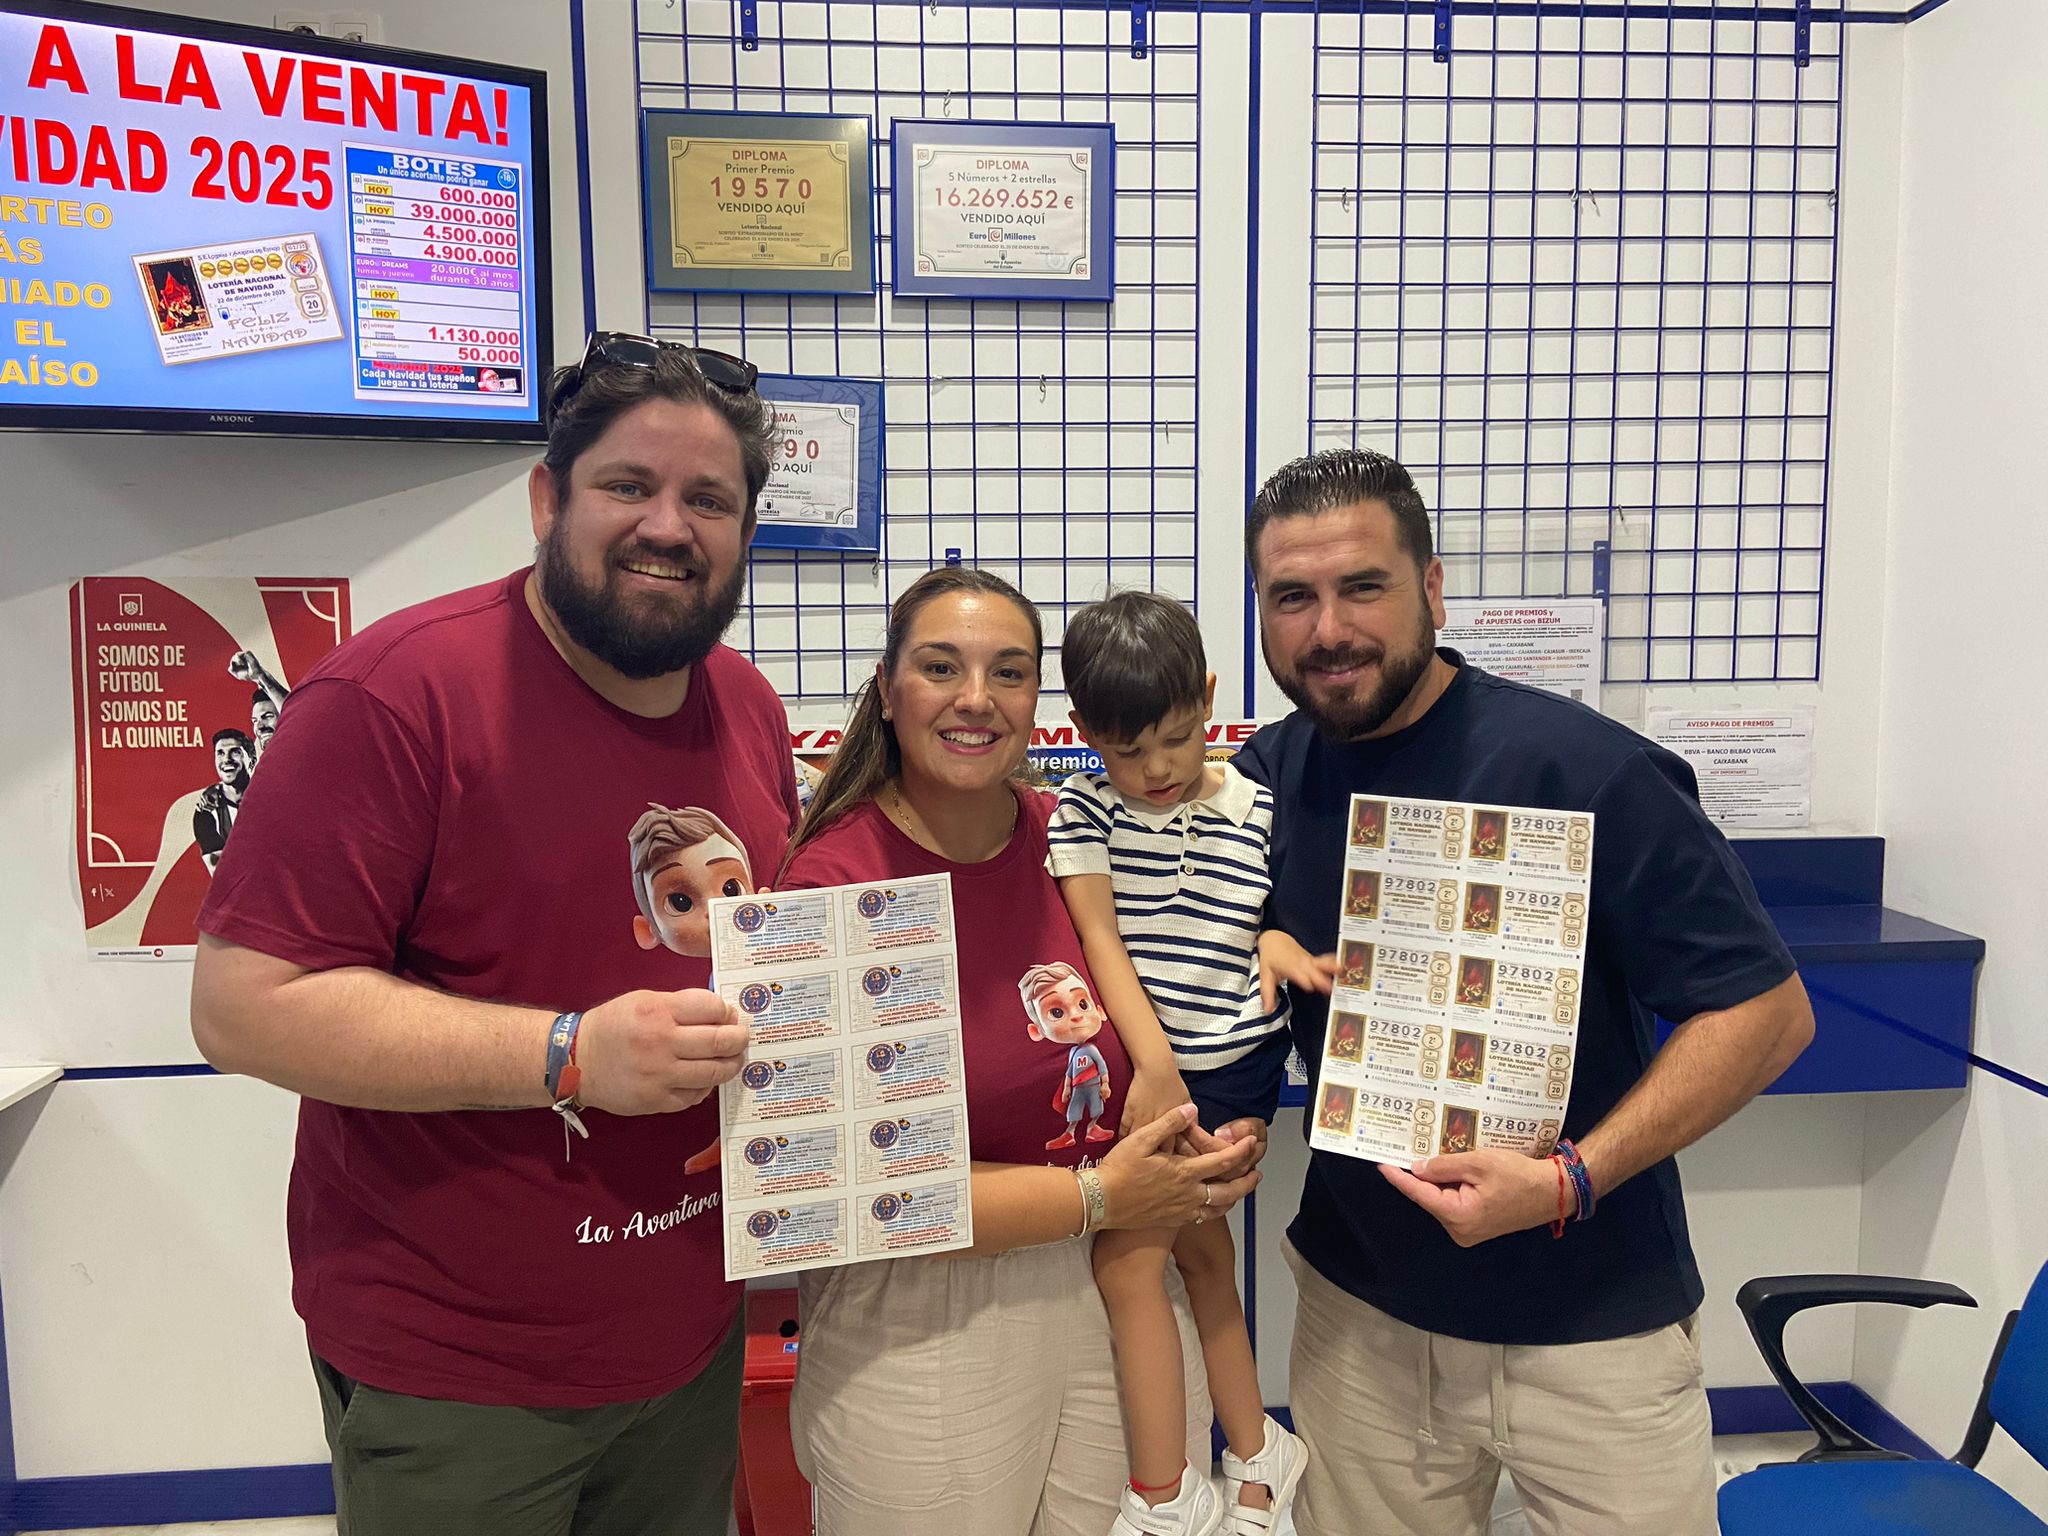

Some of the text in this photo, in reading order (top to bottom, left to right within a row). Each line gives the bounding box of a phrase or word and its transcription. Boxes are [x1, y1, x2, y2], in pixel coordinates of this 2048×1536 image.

[28, 24, 509, 147] A LA VENTA!
[0, 115, 334, 210] IDAD 2025
[732, 150, 787, 161] DIPLOMA
[393, 154, 477, 178] BOTES
[725, 163, 795, 174] Primer Premio
[976, 160, 1029, 170] DIPLOMA
[378, 165, 388, 174] Un
[390, 166, 409, 178] único
[410, 171, 445, 182] acertante
[469, 179, 488, 188] ganar
[949, 172, 954, 182] 5
[957, 171, 999, 182] Números
[1011, 174, 1017, 182] 2
[1019, 173, 1056, 184] estrellas
[368, 185, 390, 195] HOY
[440, 187, 515, 208] 600.000
[935, 187, 1074, 209] 16.269.652 €
[369, 206, 390, 215] HOY
[411, 203, 516, 227] 39.000.000
[717, 202, 805, 216] VENDIDO AQUÍ
[960, 213, 1045, 226] VENDIDO AQUÍ
[423, 224, 516, 247] 4.500.000
[969, 232, 1036, 240] Euro Millones
[424, 244, 516, 265] 4.900.000
[382, 260, 408, 269] DREAMS
[431, 264, 513, 280] 20.000€ al mes
[208, 274, 286, 289] LOTERÍA NACIONAL
[431, 274, 470, 285] durante
[474, 277, 486, 286] 30
[224, 283, 274, 296] DE NAVIDAD
[234, 292, 262, 302] diciembre
[272, 289, 286, 297] 2025
[374, 291, 395, 299] HOY
[306, 300, 319, 310] 20
[228, 312, 290, 330] FELIZ
[376, 310, 396, 319] HOY
[15, 319, 67, 347] EL
[222, 328, 308, 350] NAVIDAD
[428, 326, 519, 346] 1.130.000
[458, 347, 520, 363] 50.000
[0, 354, 98, 387] AÍSO
[362, 368, 476, 383] Cada Navidad tus sueños
[379, 377, 409, 388] juegan
[418, 380, 427, 388] la
[430, 380, 458, 390] lotería
[210, 415, 255, 423] ANSONIC
[783, 462, 812, 475] AQUÍ
[97, 622, 167, 631] LA QUINIELA
[98, 645, 186, 667] SOMOS DE
[99, 667, 164, 692] FÚTBOL
[100, 700, 188, 722] SOMOS DE
[102, 726, 204, 748] LA QUINIELA
[1391, 806, 1443, 821] 97802
[1512, 817, 1566, 832] 97802
[1385, 877, 1436, 892] 97802
[1505, 890, 1561, 906] 97802
[1567, 934, 1576, 942] 20
[1378, 948, 1429, 965] 97802
[1498, 964, 1553, 982] 97802
[1434, 991, 1442, 999] 20
[1559, 1010, 1569, 1018] 20
[1370, 1020, 1421, 1038] 97802
[1490, 1039, 1546, 1059] 97802
[1077, 1056, 1088, 1067] M
[1361, 1093, 1413, 1113] 97802
[1482, 1115, 1537, 1133] 97802
[1417, 1141, 1426, 1149] 20
[575, 1192, 721, 1244] La Aventura
